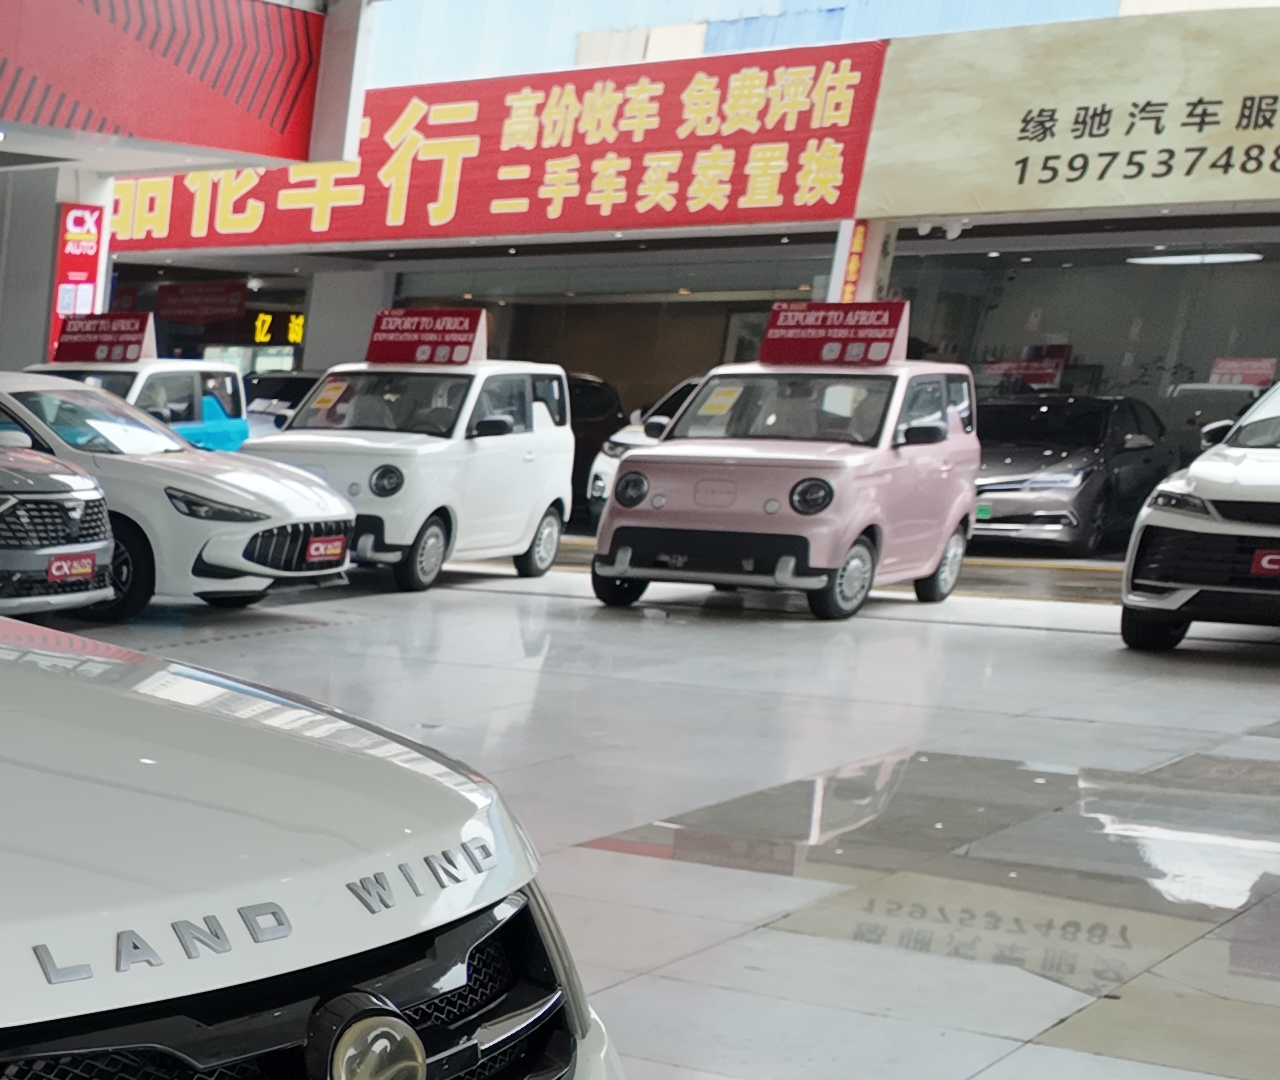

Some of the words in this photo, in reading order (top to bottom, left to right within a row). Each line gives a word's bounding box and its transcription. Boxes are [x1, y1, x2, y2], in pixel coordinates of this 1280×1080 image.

[500, 79, 666, 151] 高价收车
[675, 58, 861, 139] 免费评估
[1016, 95, 1280, 143] 缘驰汽车服
[489, 137, 845, 219] 二手车买卖置换
[65, 208, 100, 234] CX
[64, 241, 97, 256] AUTO
[380, 316, 418, 331] EXPORT
[418, 317, 433, 331] TO
[434, 317, 470, 331] AFRICA
[776, 310, 824, 326] EXPORT
[824, 311, 845, 326] TO
[844, 310, 890, 326] AFRICA
[51, 560, 70, 576] CX
[31, 900, 293, 985] LAND
[344, 836, 498, 915] WIND
